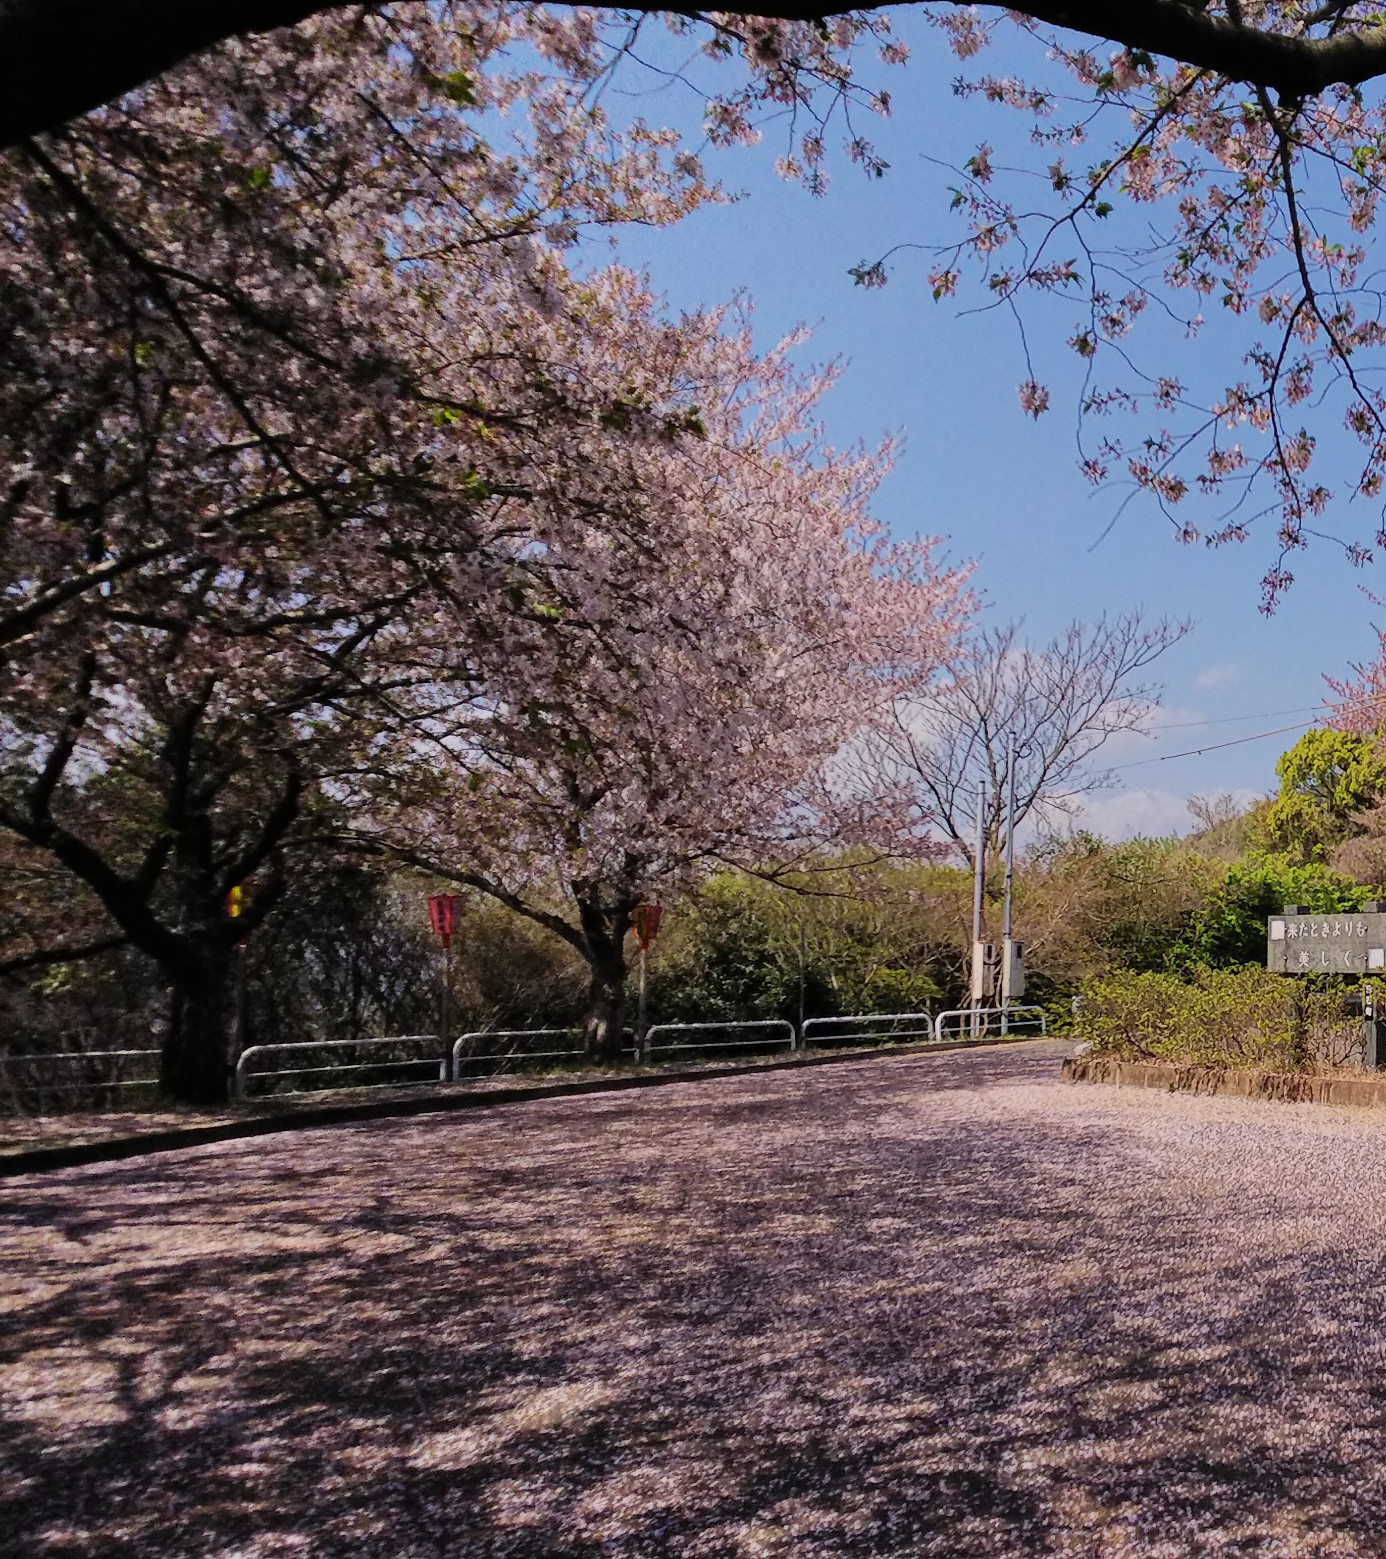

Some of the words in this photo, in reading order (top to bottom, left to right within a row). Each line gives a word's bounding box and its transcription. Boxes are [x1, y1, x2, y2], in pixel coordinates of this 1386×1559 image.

[1287, 920, 1367, 939] 来たときよりも
[1298, 950, 1352, 967] 美しく
